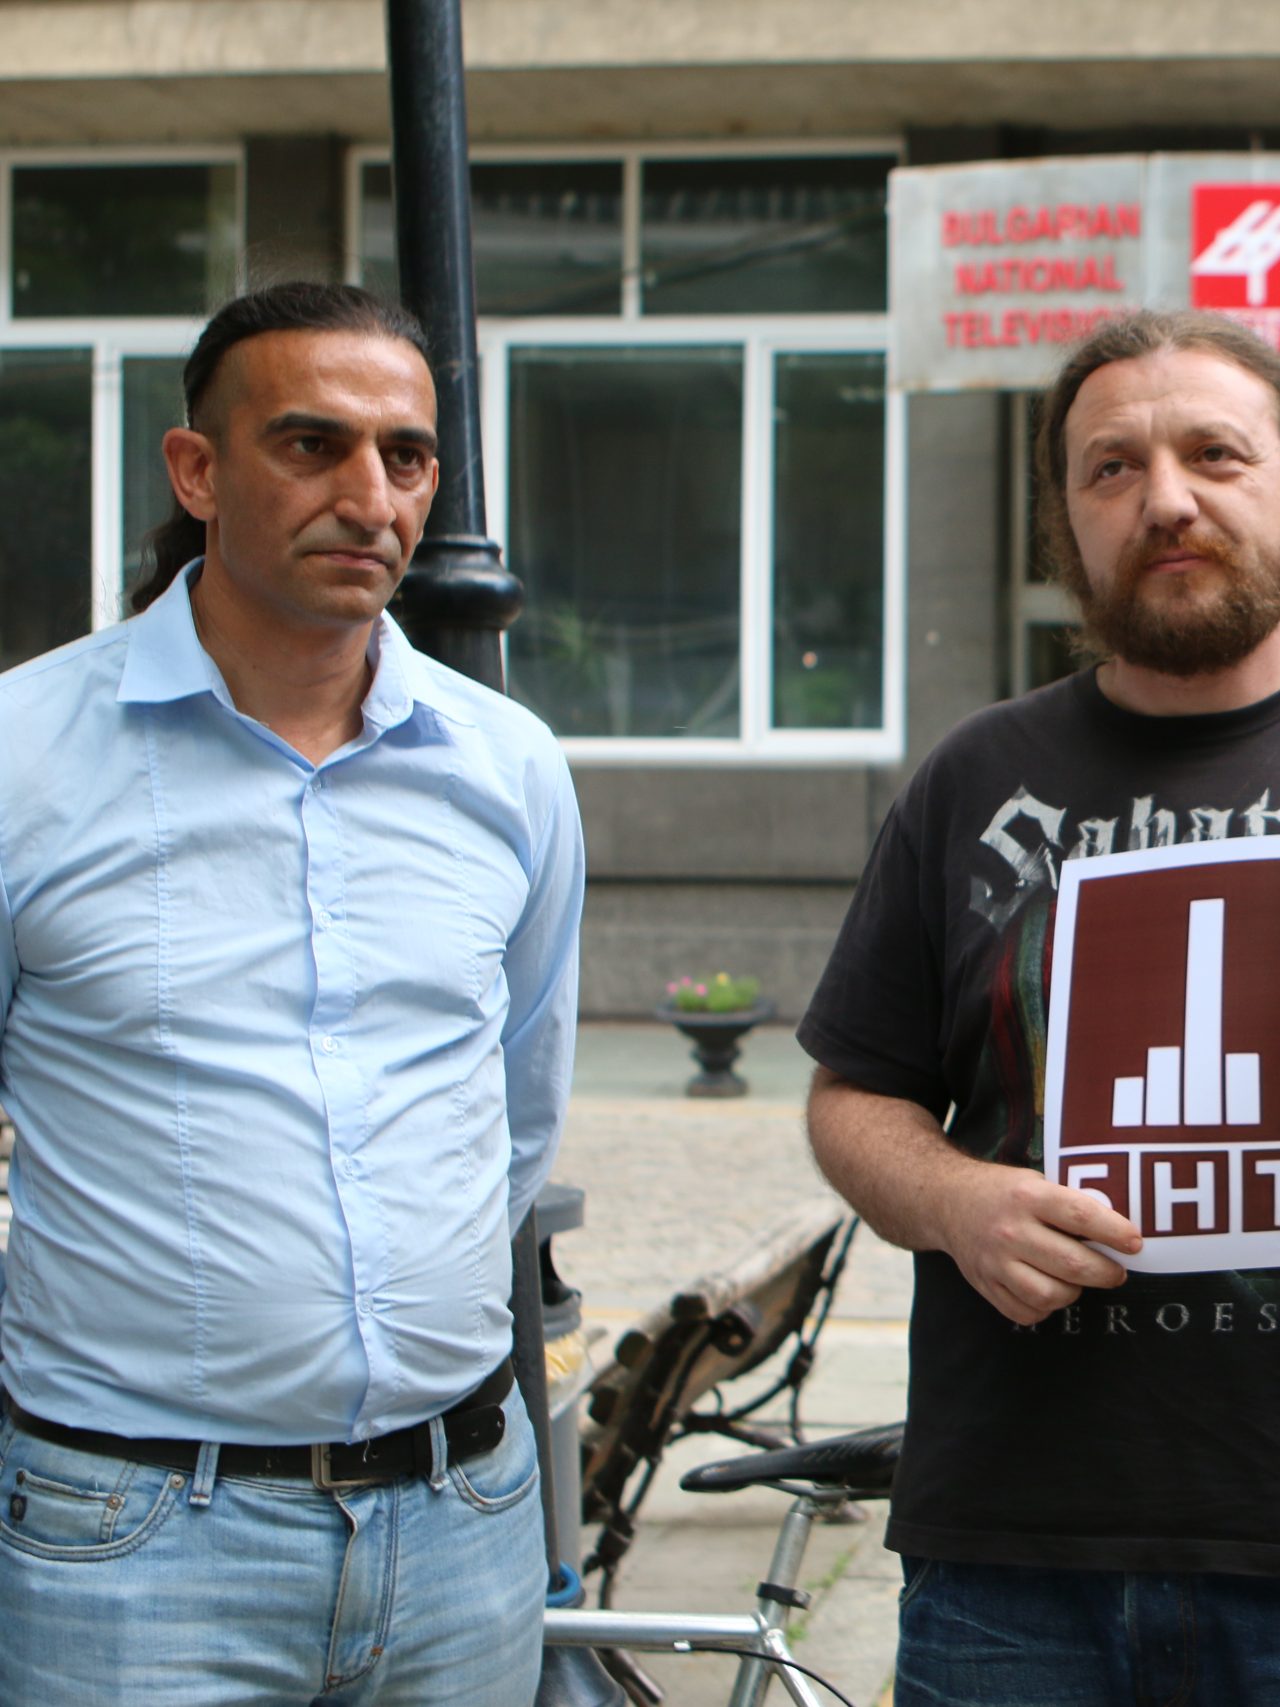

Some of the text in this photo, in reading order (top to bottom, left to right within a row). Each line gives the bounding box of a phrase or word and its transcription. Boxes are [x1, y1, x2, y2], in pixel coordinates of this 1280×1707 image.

[943, 204, 1140, 247] BULGARIAN
[955, 257, 1124, 295] NATIONAL
[945, 307, 1112, 348] TELEVISI
[1011, 1302, 1278, 1334] EROES
